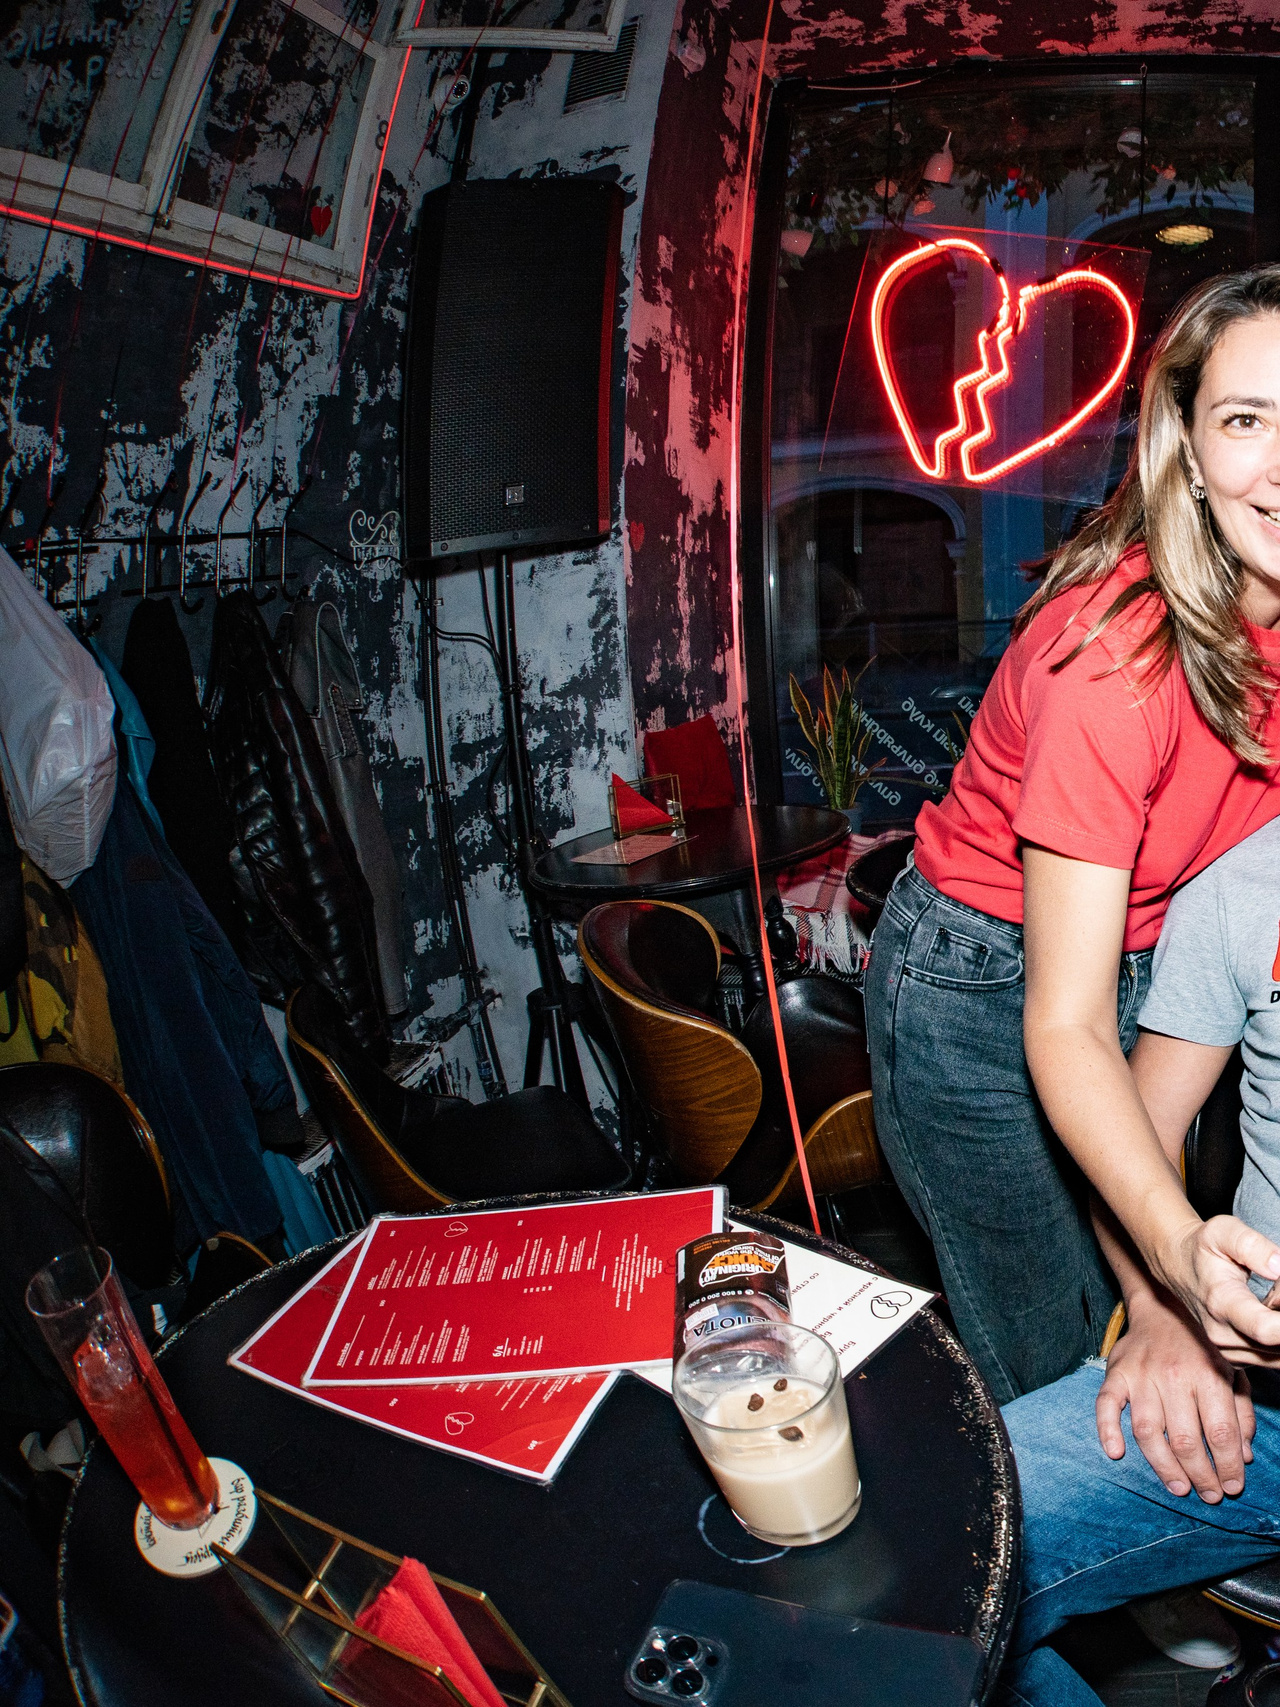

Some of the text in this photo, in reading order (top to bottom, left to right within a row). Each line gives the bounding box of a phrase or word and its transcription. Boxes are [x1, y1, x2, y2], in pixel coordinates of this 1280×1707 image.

[703, 1263, 765, 1277] ORIGINAL
[708, 1253, 775, 1272] CHOICE
[791, 1279, 810, 1295] стра
[843, 1281, 873, 1307] красной
[688, 1299, 700, 1308] 200
[707, 1292, 720, 1300] 200
[229, 1477, 247, 1496] бар
